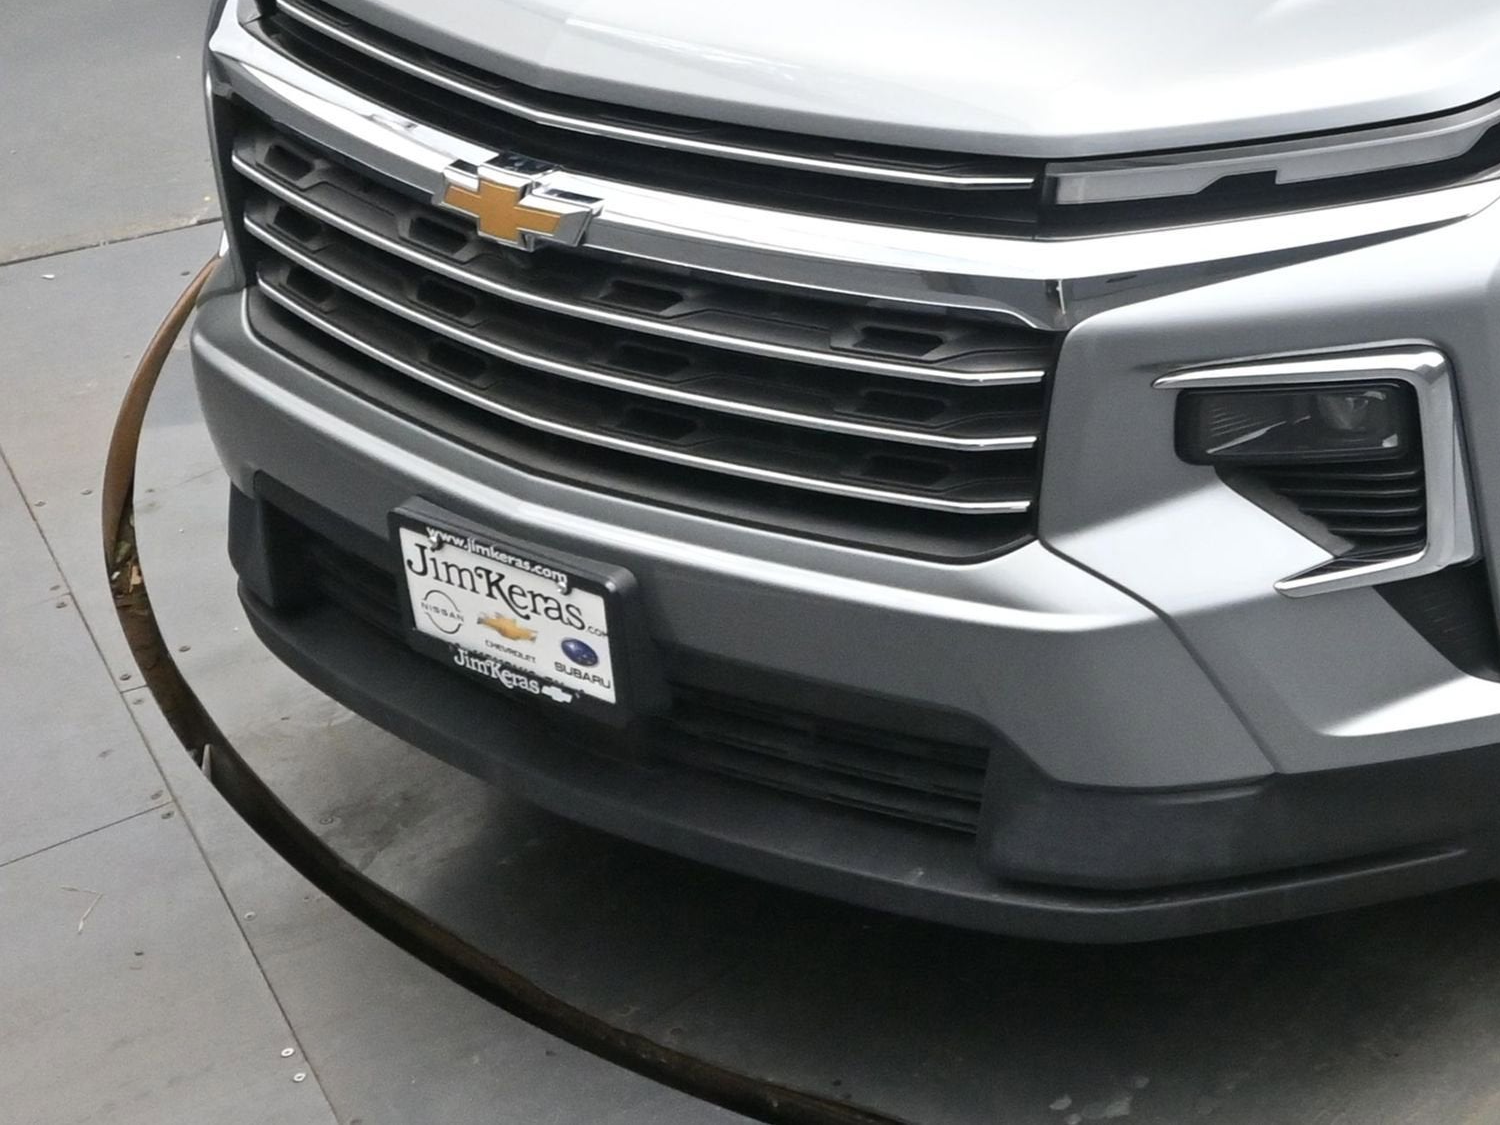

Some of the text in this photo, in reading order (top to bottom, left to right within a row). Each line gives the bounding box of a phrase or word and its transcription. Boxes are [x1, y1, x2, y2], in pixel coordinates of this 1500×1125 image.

[426, 526, 568, 585] www.jimkeras.com
[421, 601, 464, 623] NISSAN
[484, 640, 536, 663] CHEVROLET
[554, 661, 611, 689] SUBARU
